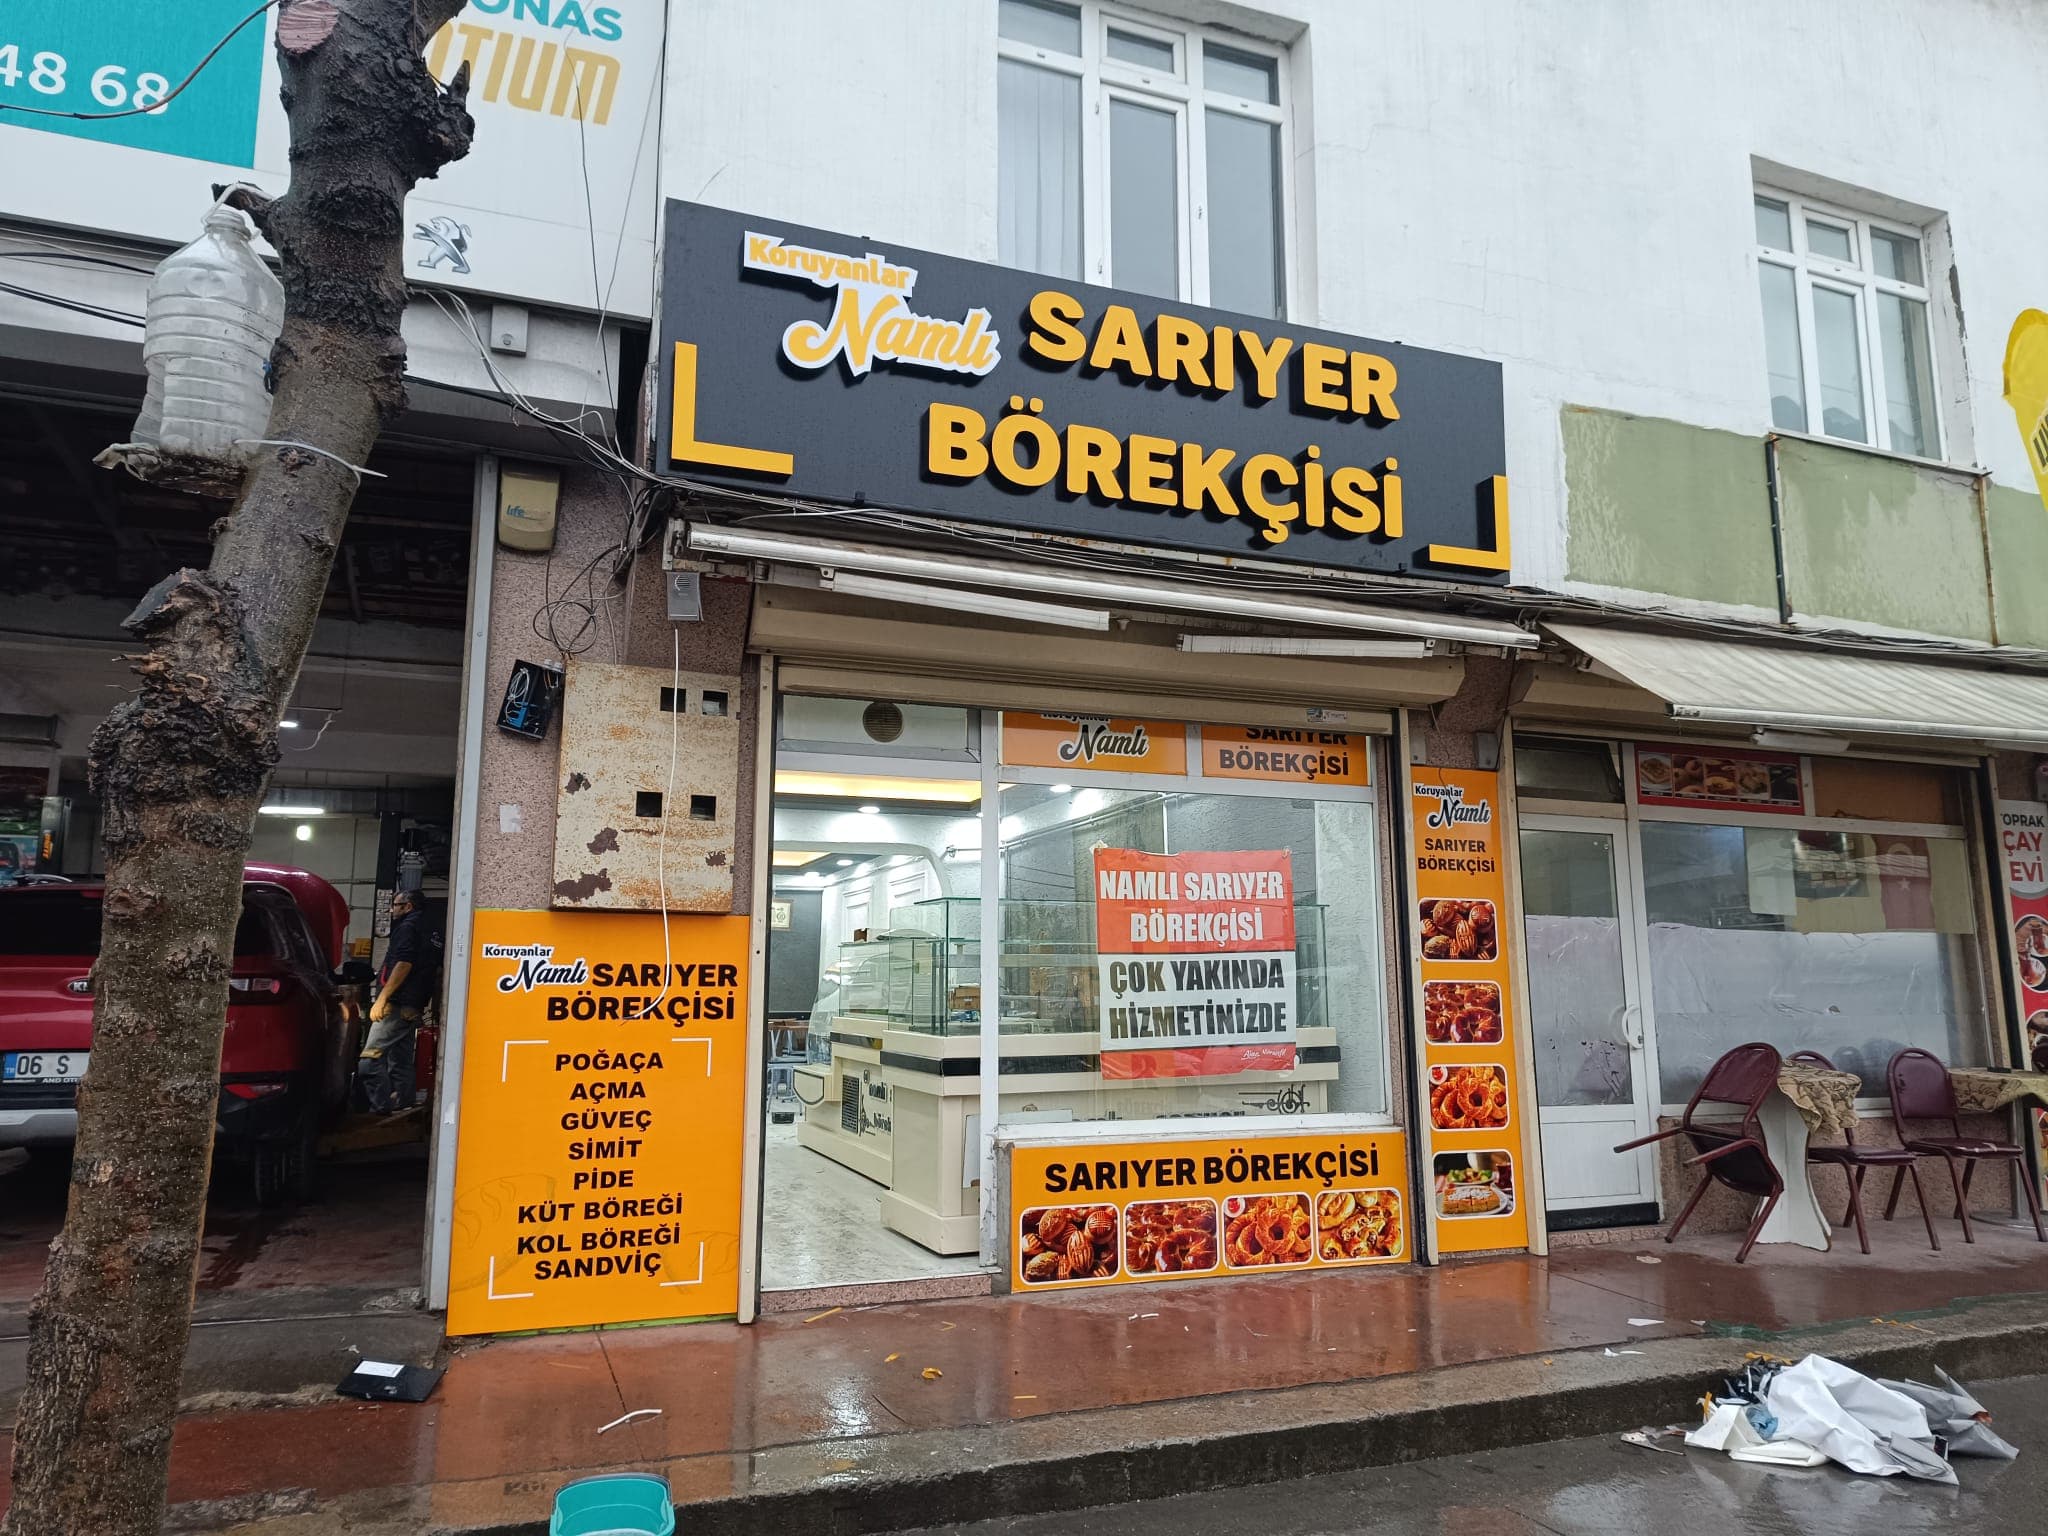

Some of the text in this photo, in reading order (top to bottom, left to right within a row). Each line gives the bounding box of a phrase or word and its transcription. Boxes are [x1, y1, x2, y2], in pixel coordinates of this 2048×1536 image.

[90, 64, 170, 115] 68
[750, 237, 910, 290] Koruyanlar
[787, 288, 1401, 421] Namlı SARIYER
[928, 395, 1404, 544] BÖREKÇİSİ
[1060, 724, 1148, 760] Namlı
[1219, 745, 1349, 780] BÖREKÇİSİ
[1415, 785, 1463, 798] Koruyanlar
[1428, 799, 1491, 828] Namlı
[2000, 813, 2045, 828] OPRAK
[1424, 838, 1487, 853] SARIYER
[2003, 830, 2043, 857] ÇAY
[1417, 854, 1496, 876] BÖREKÇİSİ
[2009, 855, 2045, 882] EVİ
[1100, 870, 1284, 901] NAMLI SARIYER
[1130, 907, 1264, 947] BÖREKÇİSİ
[484, 946, 552, 958] Koruyanlar
[499, 959, 739, 991] Namlı SARIYER
[1109, 958, 1285, 1000] ÇOK YAKINDA
[547, 990, 736, 1028] BÖREKÇİSİ
[1109, 998, 1287, 1039] HİZMETİNİZDE
[17, 1055, 43, 1075] 06
[56, 1055, 70, 1075] S
[555, 1049, 664, 1074] POĞAÇA
[570, 1081, 646, 1105] AÇMA
[561, 1108, 653, 1132] GÜVEÇ
[568, 1136, 642, 1160] SİMİT
[573, 1167, 634, 1190] PİDE
[1045, 1142, 1379, 1193] SARIYER BÖREKÇİSİ
[518, 1192, 683, 1224] KÜT BÖREĞİ
[517, 1222, 680, 1255] KOL BÖREĞİ
[534, 1250, 662, 1280] SANDVİÇ
